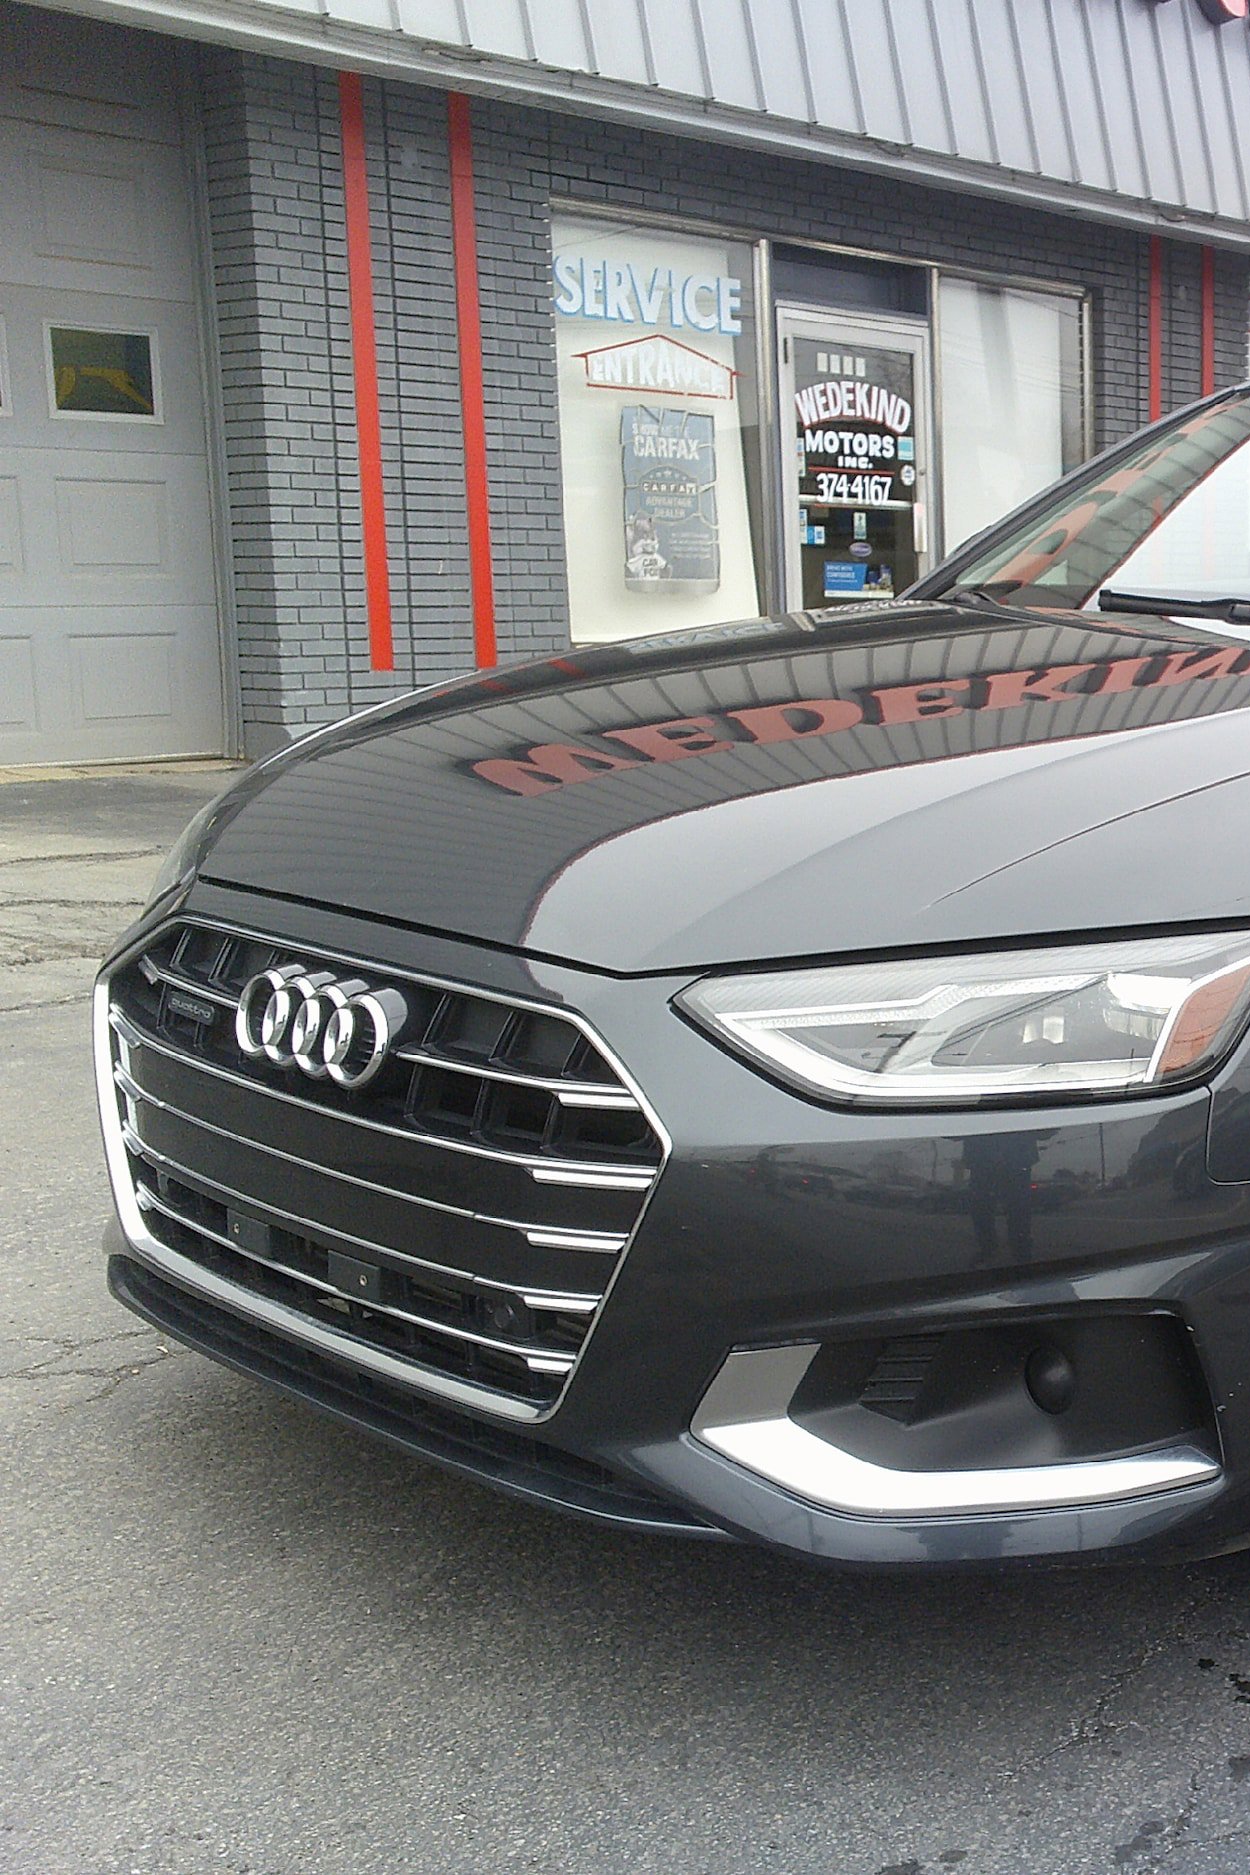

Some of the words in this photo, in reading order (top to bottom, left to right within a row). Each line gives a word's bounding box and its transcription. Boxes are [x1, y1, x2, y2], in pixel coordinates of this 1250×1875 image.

[553, 256, 742, 335] SERVICE
[795, 380, 912, 435] WEDEKIND
[633, 434, 700, 460] CARFAX
[805, 429, 895, 458] MOTORS
[838, 456, 874, 469] INC.
[817, 472, 893, 506] 374-4167
[171, 998, 211, 1019] quattro
